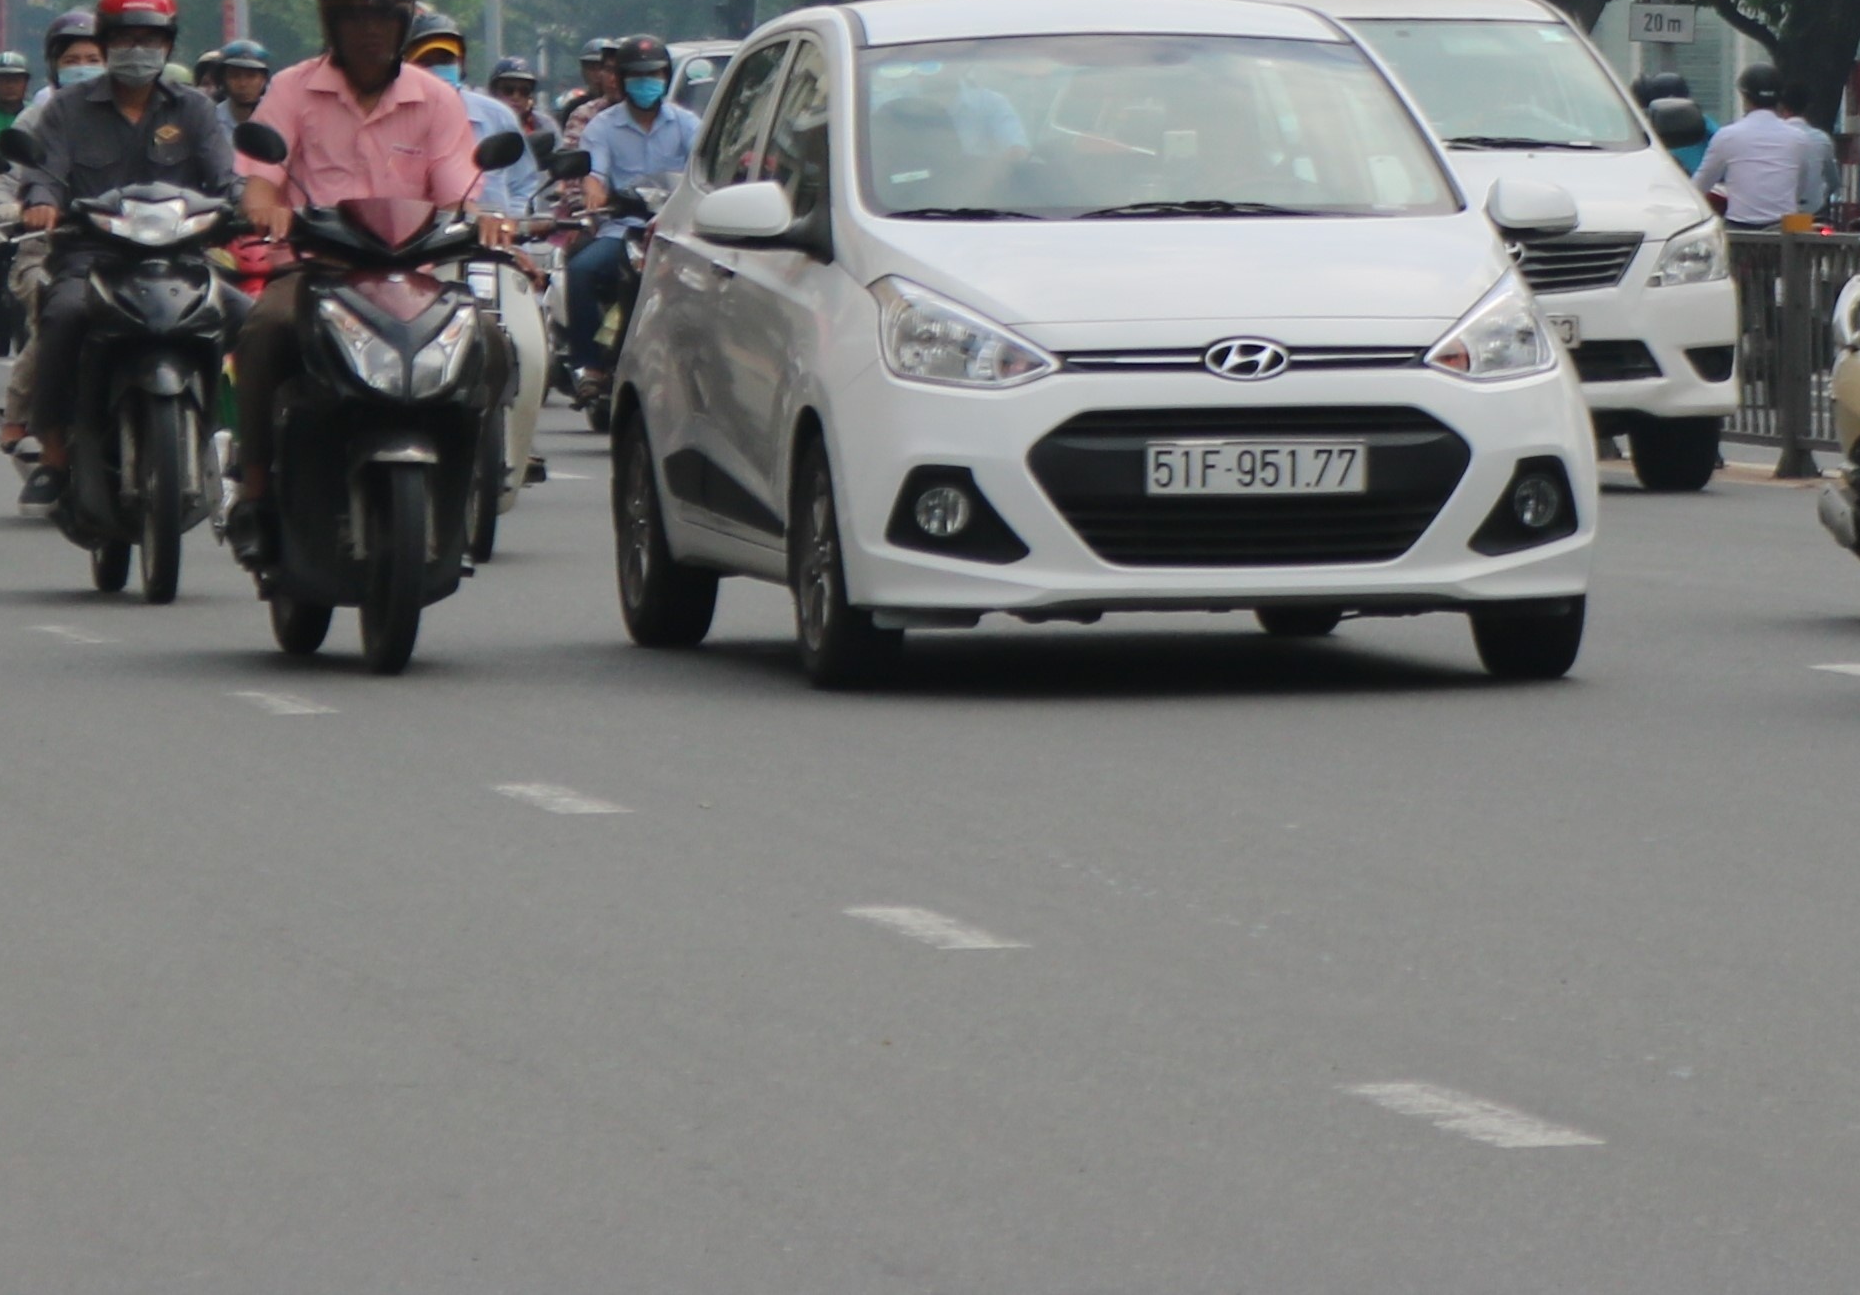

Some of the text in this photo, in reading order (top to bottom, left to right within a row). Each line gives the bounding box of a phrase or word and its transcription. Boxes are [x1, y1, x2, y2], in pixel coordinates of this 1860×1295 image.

[1644, 13, 1681, 33] 20 m
[1153, 449, 1357, 488] 51F-951.77
